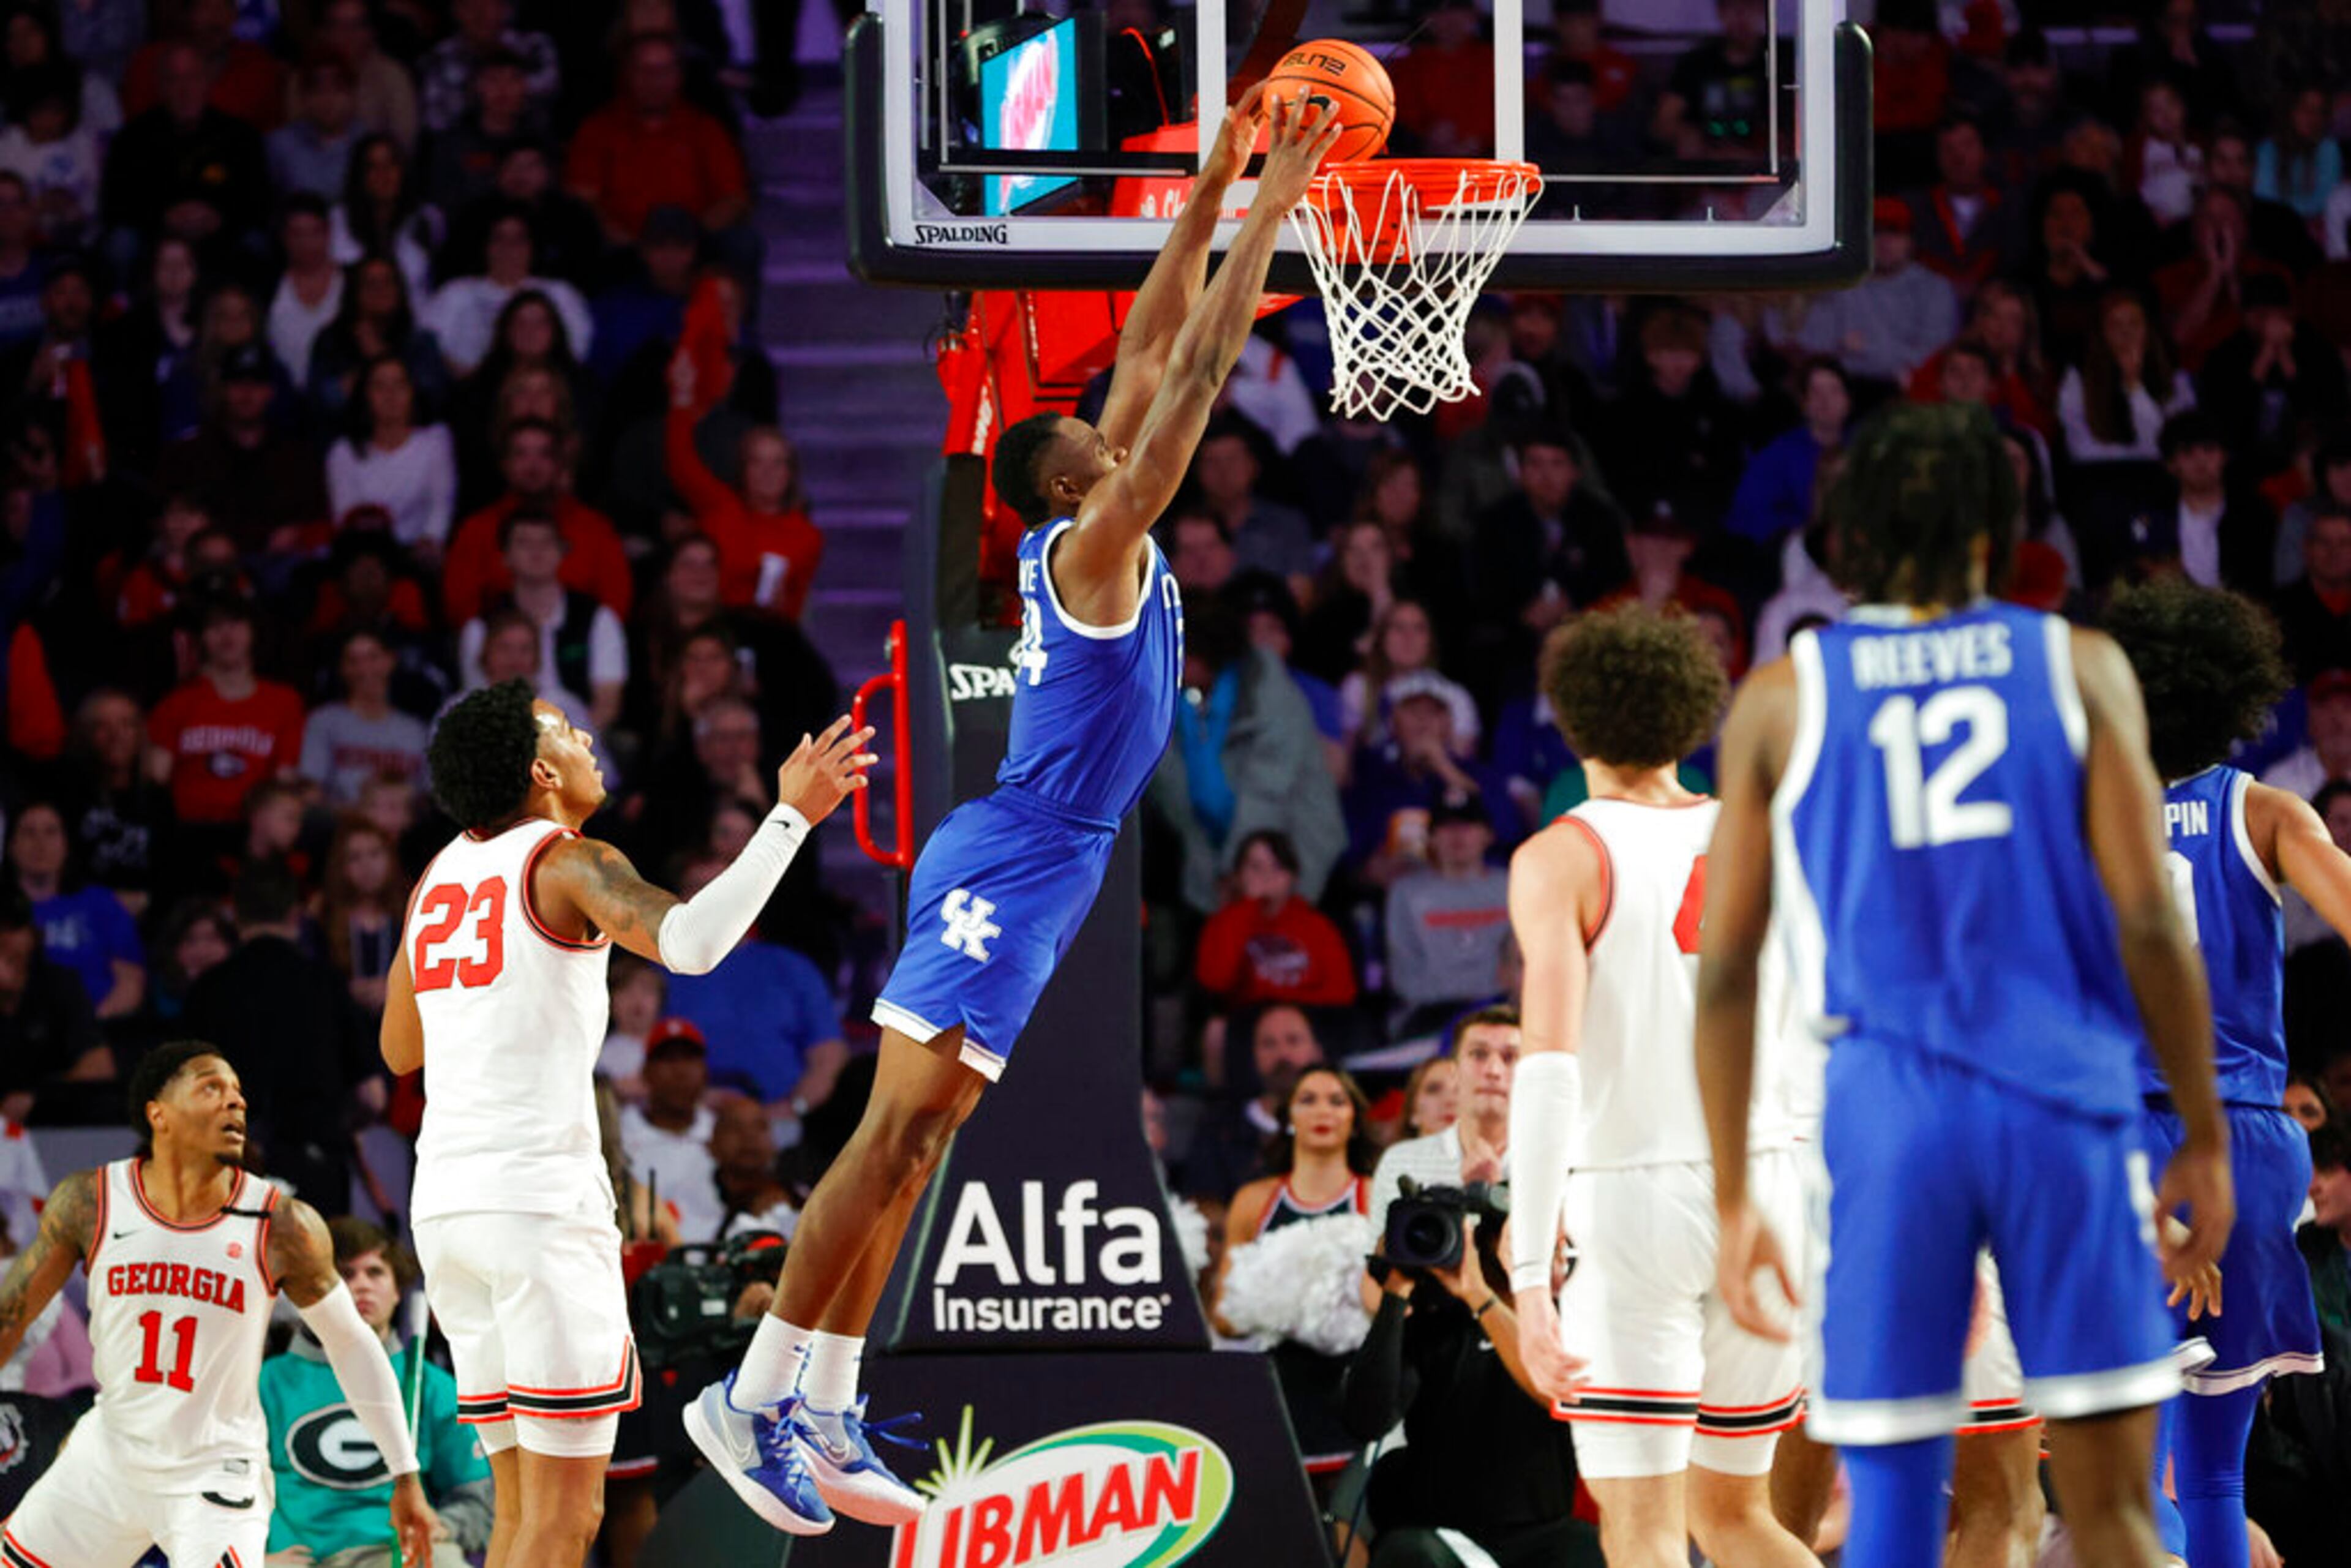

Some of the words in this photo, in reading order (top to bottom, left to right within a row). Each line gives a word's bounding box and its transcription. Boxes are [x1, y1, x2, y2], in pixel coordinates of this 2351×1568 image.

[915, 224, 1007, 244] SPALDING
[950, 664, 1017, 701] SPA
[1852, 623, 2012, 690] REEVES
[1869, 686, 2012, 849] 12
[2164, 801, 2208, 838] PIN
[414, 876, 507, 993] 23
[934, 1179, 1162, 1286] Alfa
[108, 1262, 244, 1313] GEORGIA
[934, 1287, 1163, 1332] Insurance
[135, 1310, 198, 1393] 11
